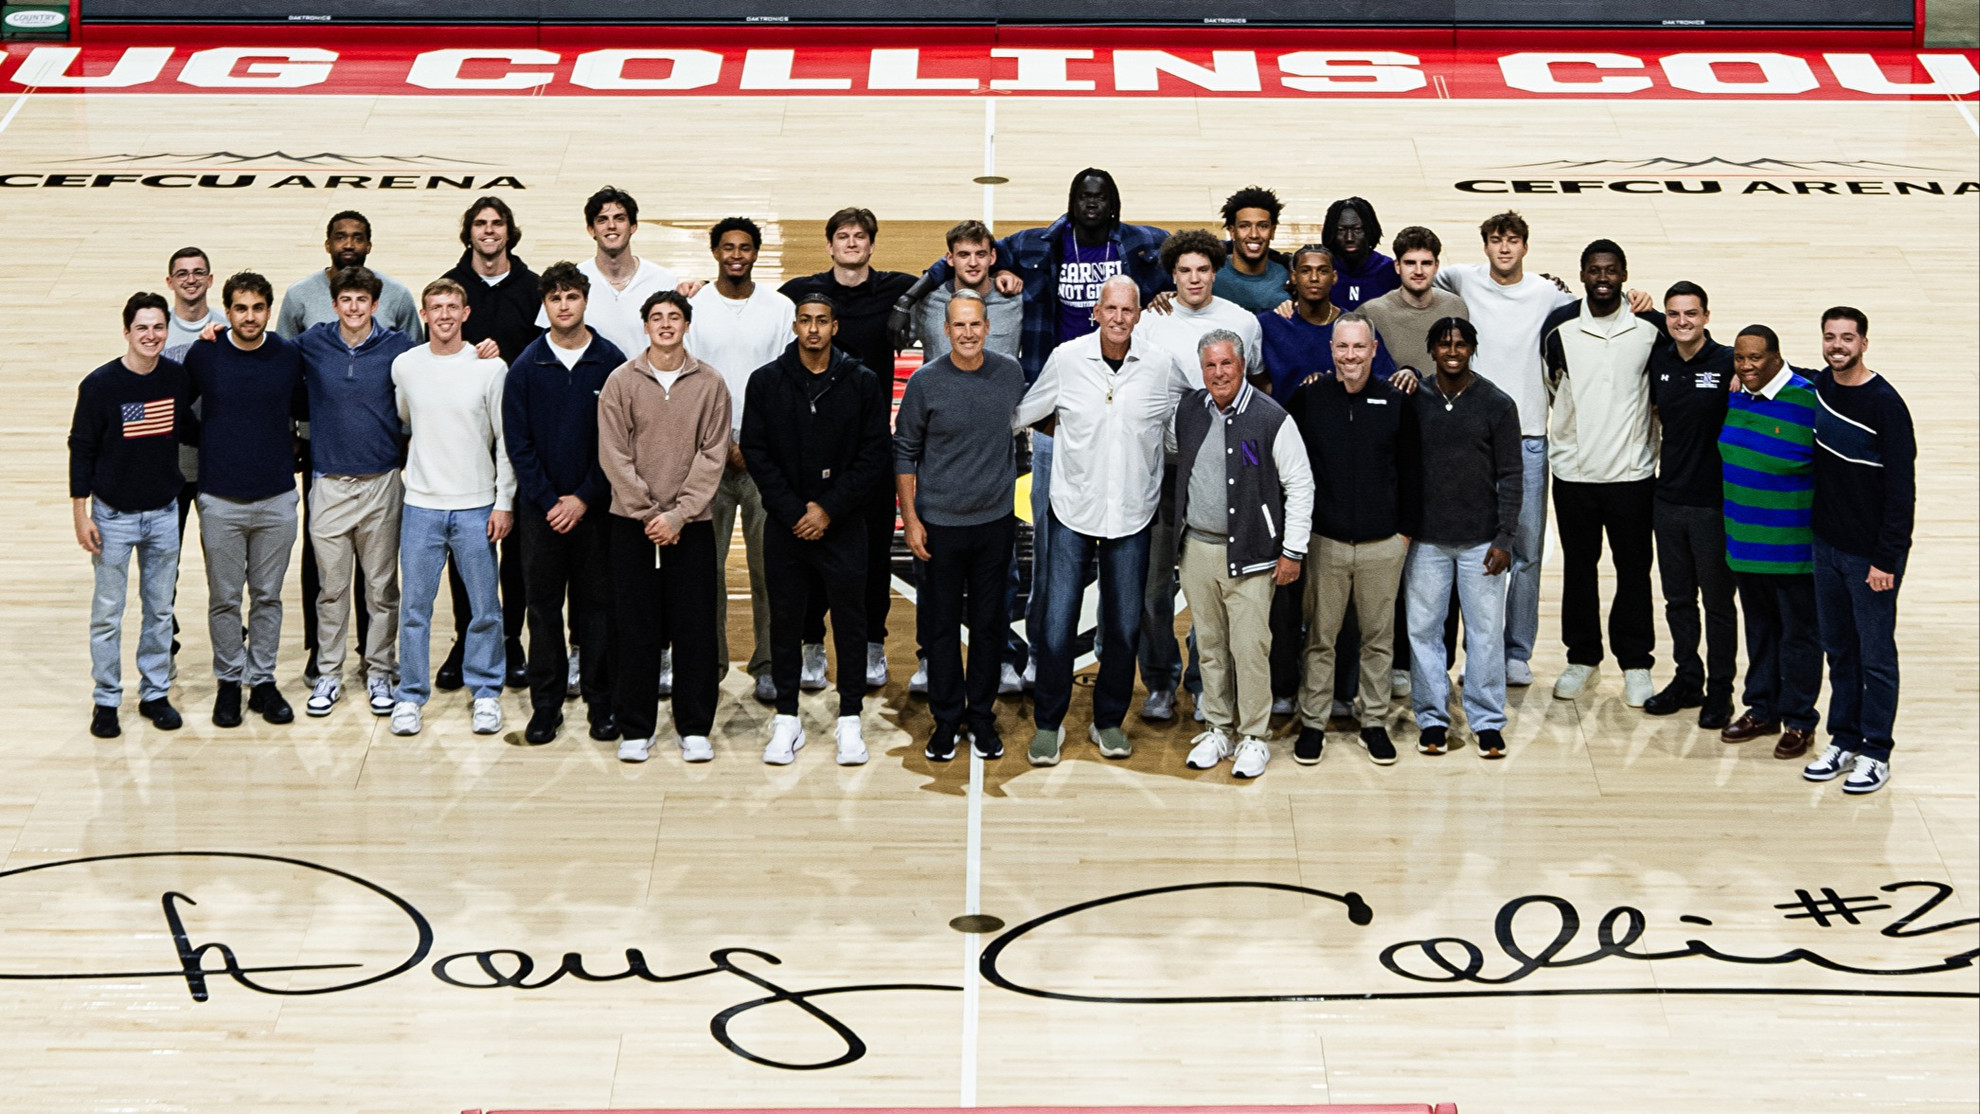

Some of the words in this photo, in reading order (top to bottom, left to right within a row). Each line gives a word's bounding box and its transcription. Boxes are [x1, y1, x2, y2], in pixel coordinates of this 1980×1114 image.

[13, 14, 57, 22] COUNTRY
[0, 46, 340, 88] UG
[405, 48, 1428, 93] COLLINS
[0, 174, 257, 189] CEFCU
[269, 175, 526, 190] ARENA
[1455, 180, 1722, 194] CEFCU
[1742, 181, 1979, 195] ARENA
[1058, 284, 1084, 300] NOT
[1349, 286, 1360, 301] N
[1241, 440, 1259, 466] N
[979, 881, 1979, 1004] Collin
